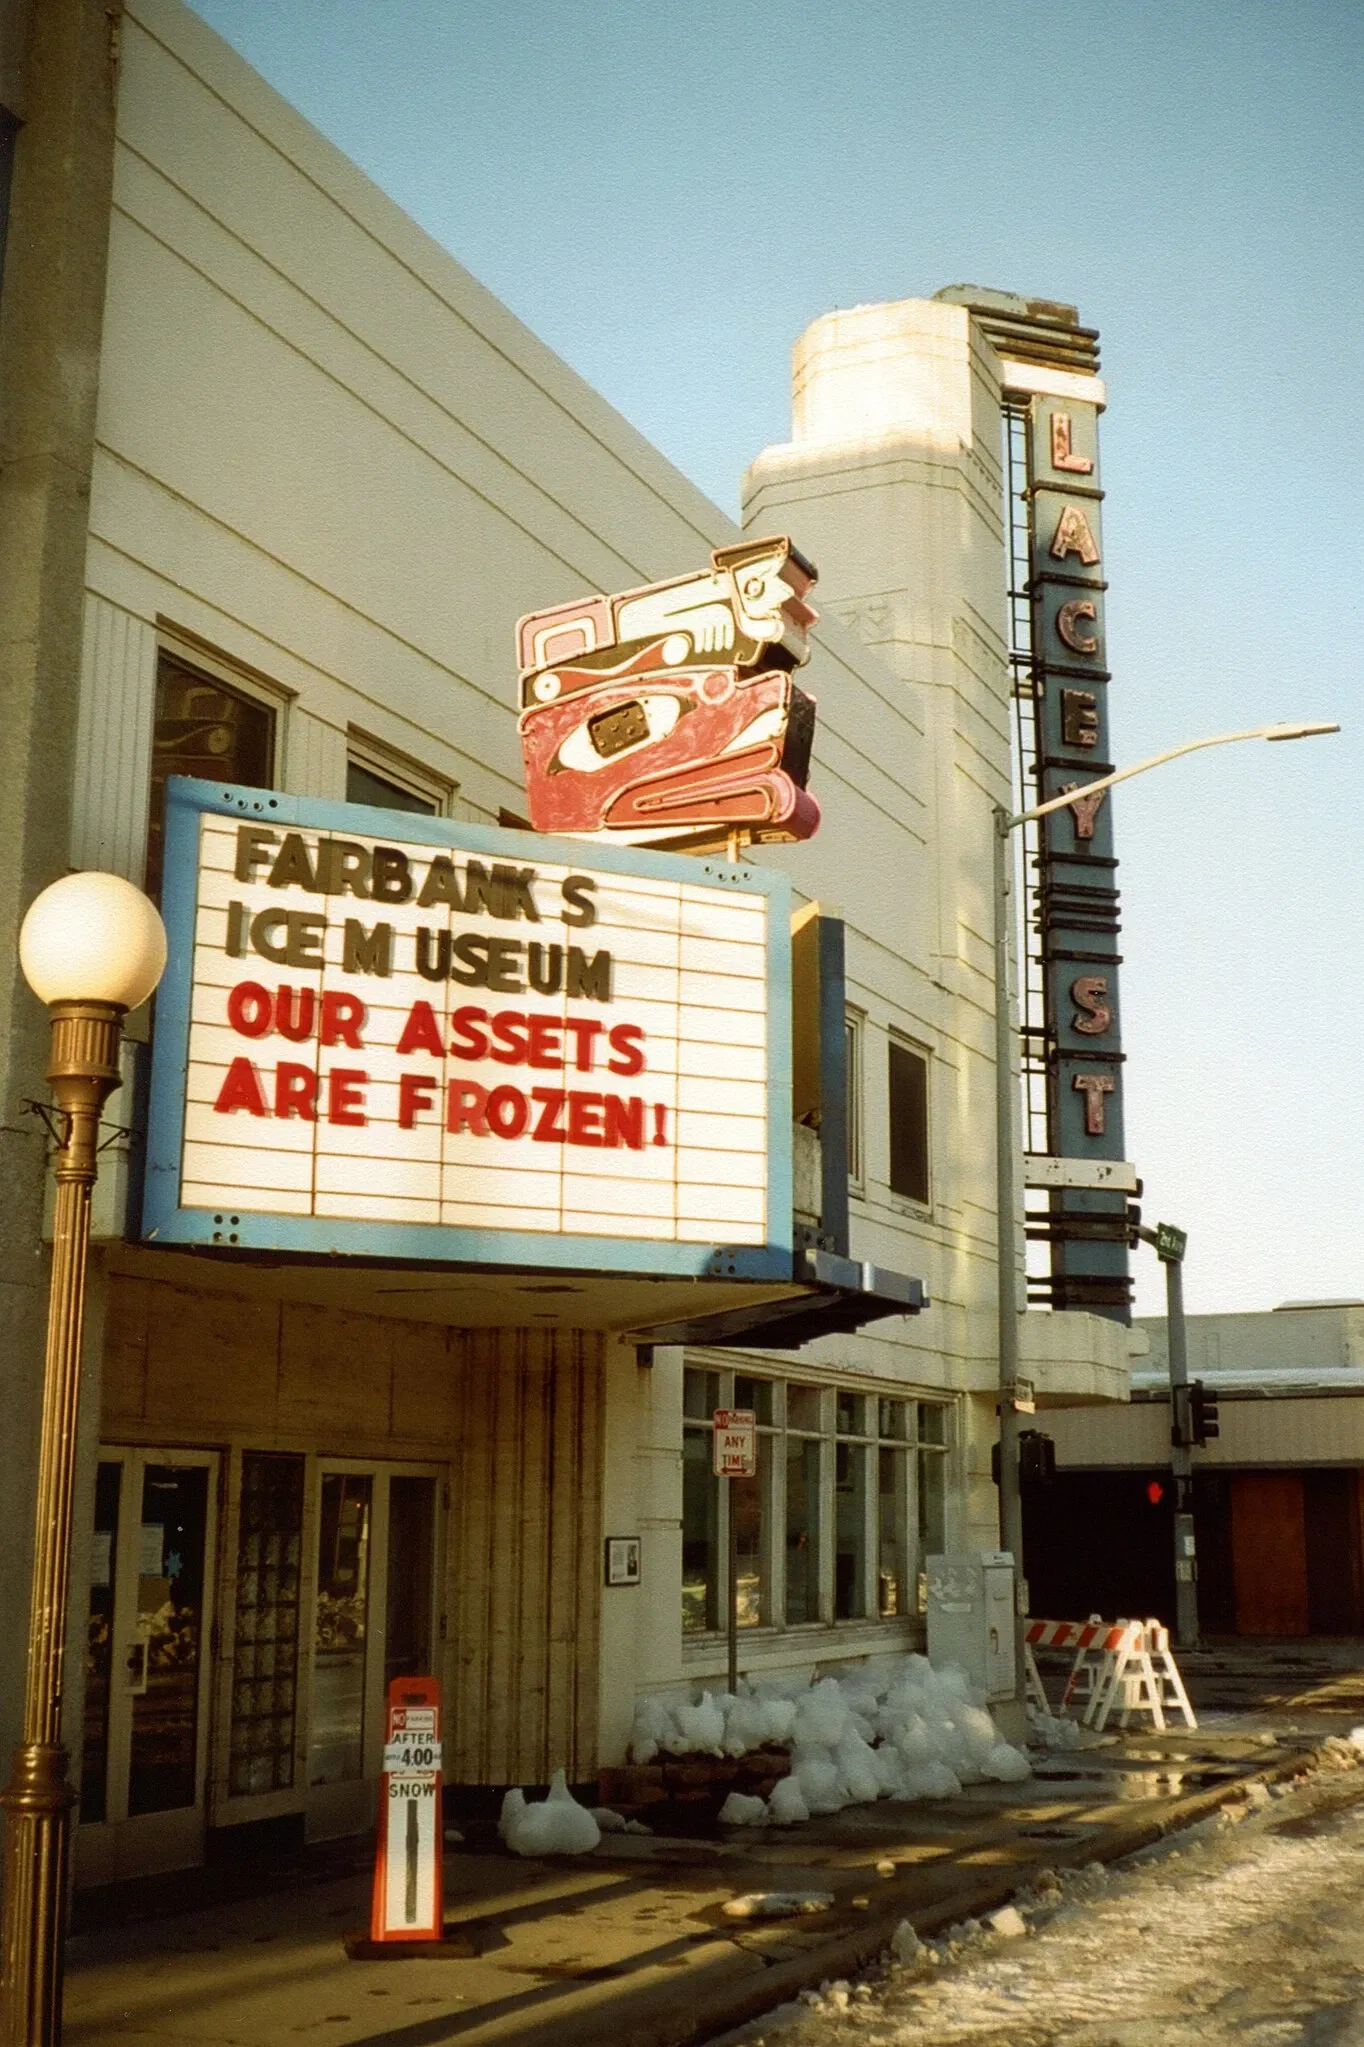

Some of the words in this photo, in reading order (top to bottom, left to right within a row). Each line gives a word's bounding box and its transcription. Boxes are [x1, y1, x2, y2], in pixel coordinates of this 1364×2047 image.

[1050, 412, 1105, 840] LACEY
[225, 900, 327, 970] ICE
[342, 917, 613, 1004] MUSEUM
[228, 980, 367, 1050] OUR
[396, 1000, 647, 1078] ASSETS
[1070, 975, 1115, 1136] ST
[213, 1056, 371, 1127] ARE
[399, 1073, 668, 1150] FROZEN!
[722, 1453, 746, 1467] TIME
[724, 1436, 745, 1448] ANY
[391, 1732, 434, 1745] AFTER
[393, 1712, 406, 1726] NO
[389, 1783, 434, 1798] SNOW
